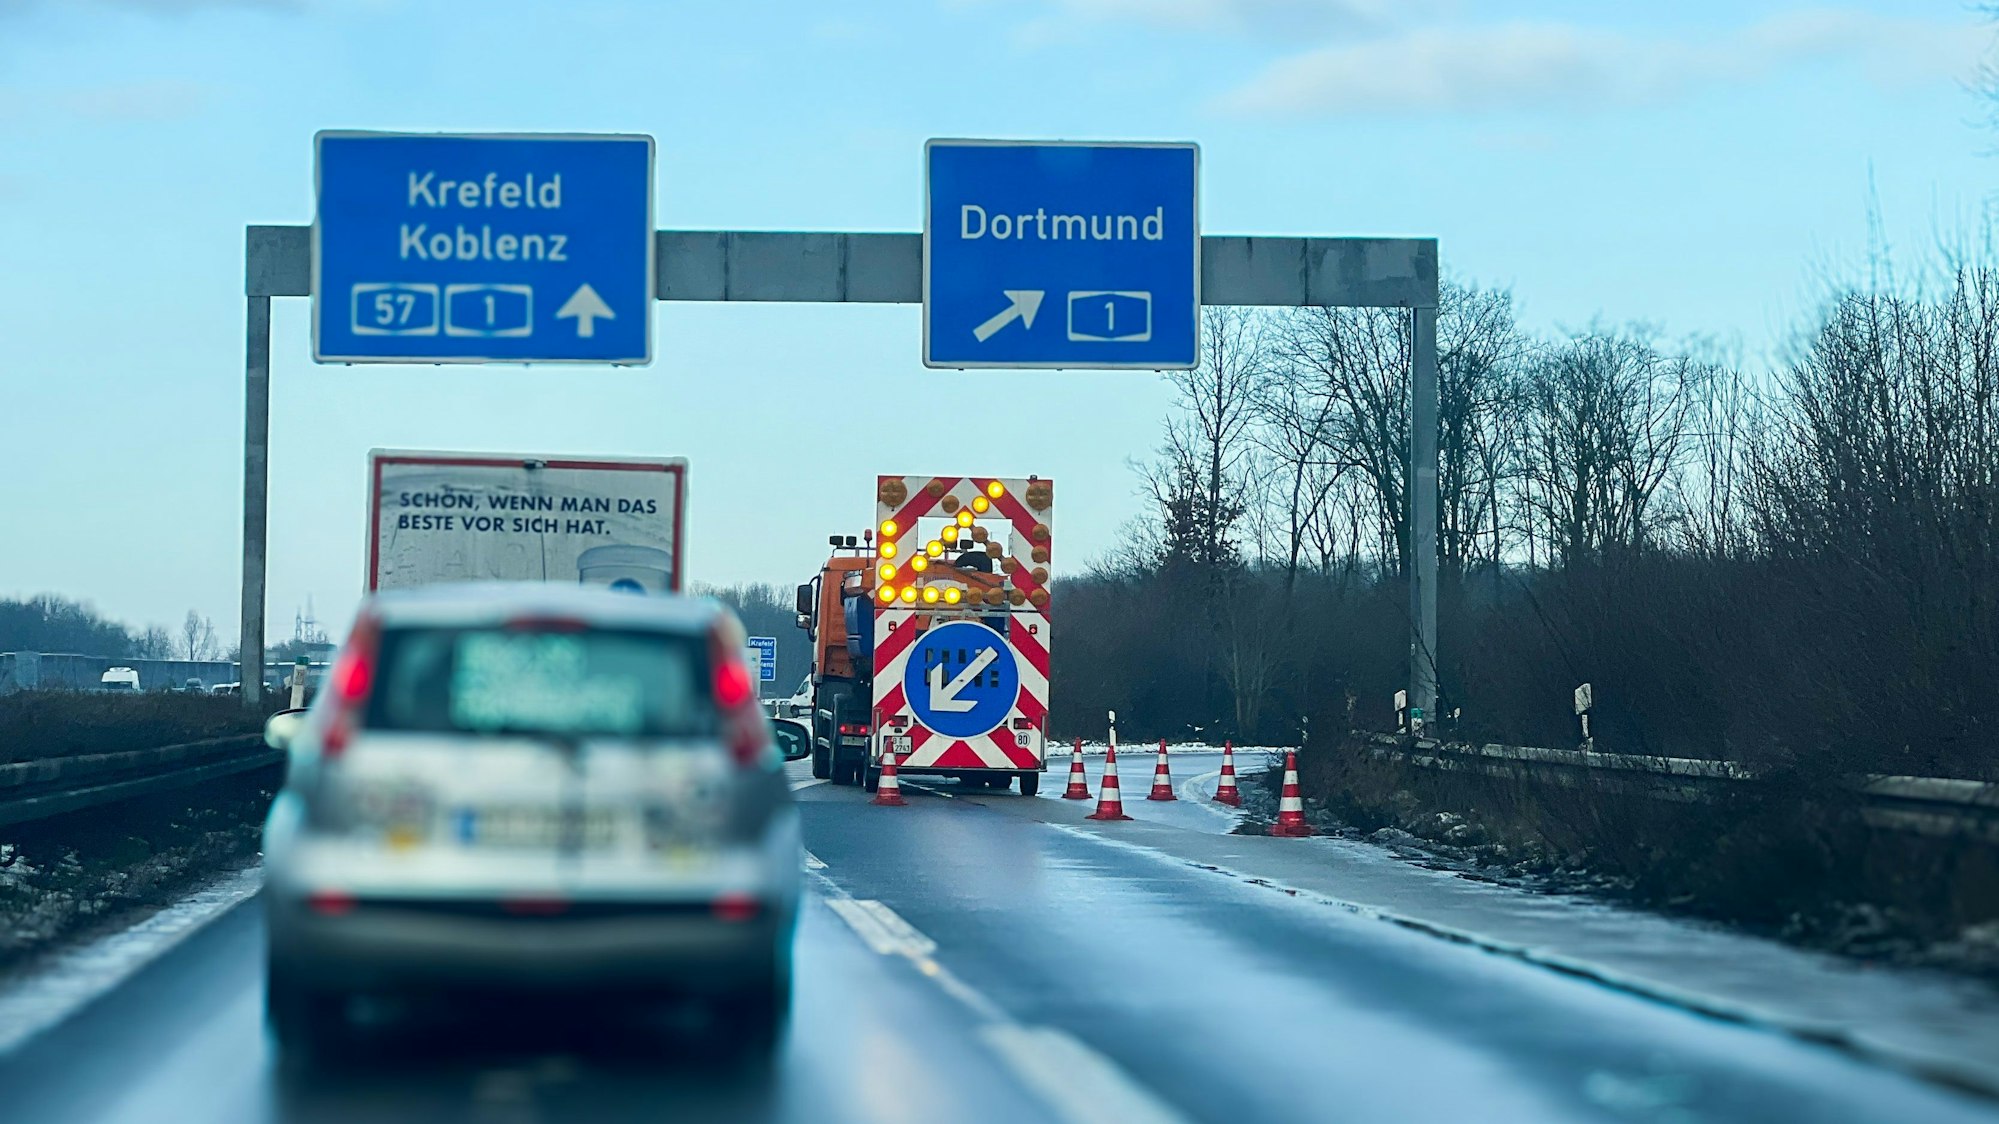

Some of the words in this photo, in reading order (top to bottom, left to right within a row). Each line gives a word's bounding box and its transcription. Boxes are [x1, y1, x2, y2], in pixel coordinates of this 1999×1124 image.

[408, 171, 563, 209] Krefeld
[960, 204, 1164, 241] Dortmund
[400, 224, 568, 261] Koblenz
[375, 295, 415, 325] 57
[484, 296, 495, 325] 1
[1104, 301, 1115, 331] 1
[400, 487, 480, 512] SCHÖN,
[488, 495, 553, 512] WENN
[560, 497, 611, 514] MAN
[618, 498, 657, 515] DAS
[398, 514, 454, 531] BESTE
[461, 515, 505, 533] VOR
[512, 517, 559, 534] SICH
[565, 518, 611, 536] HAT.
[1018, 734, 1028, 745] 80
